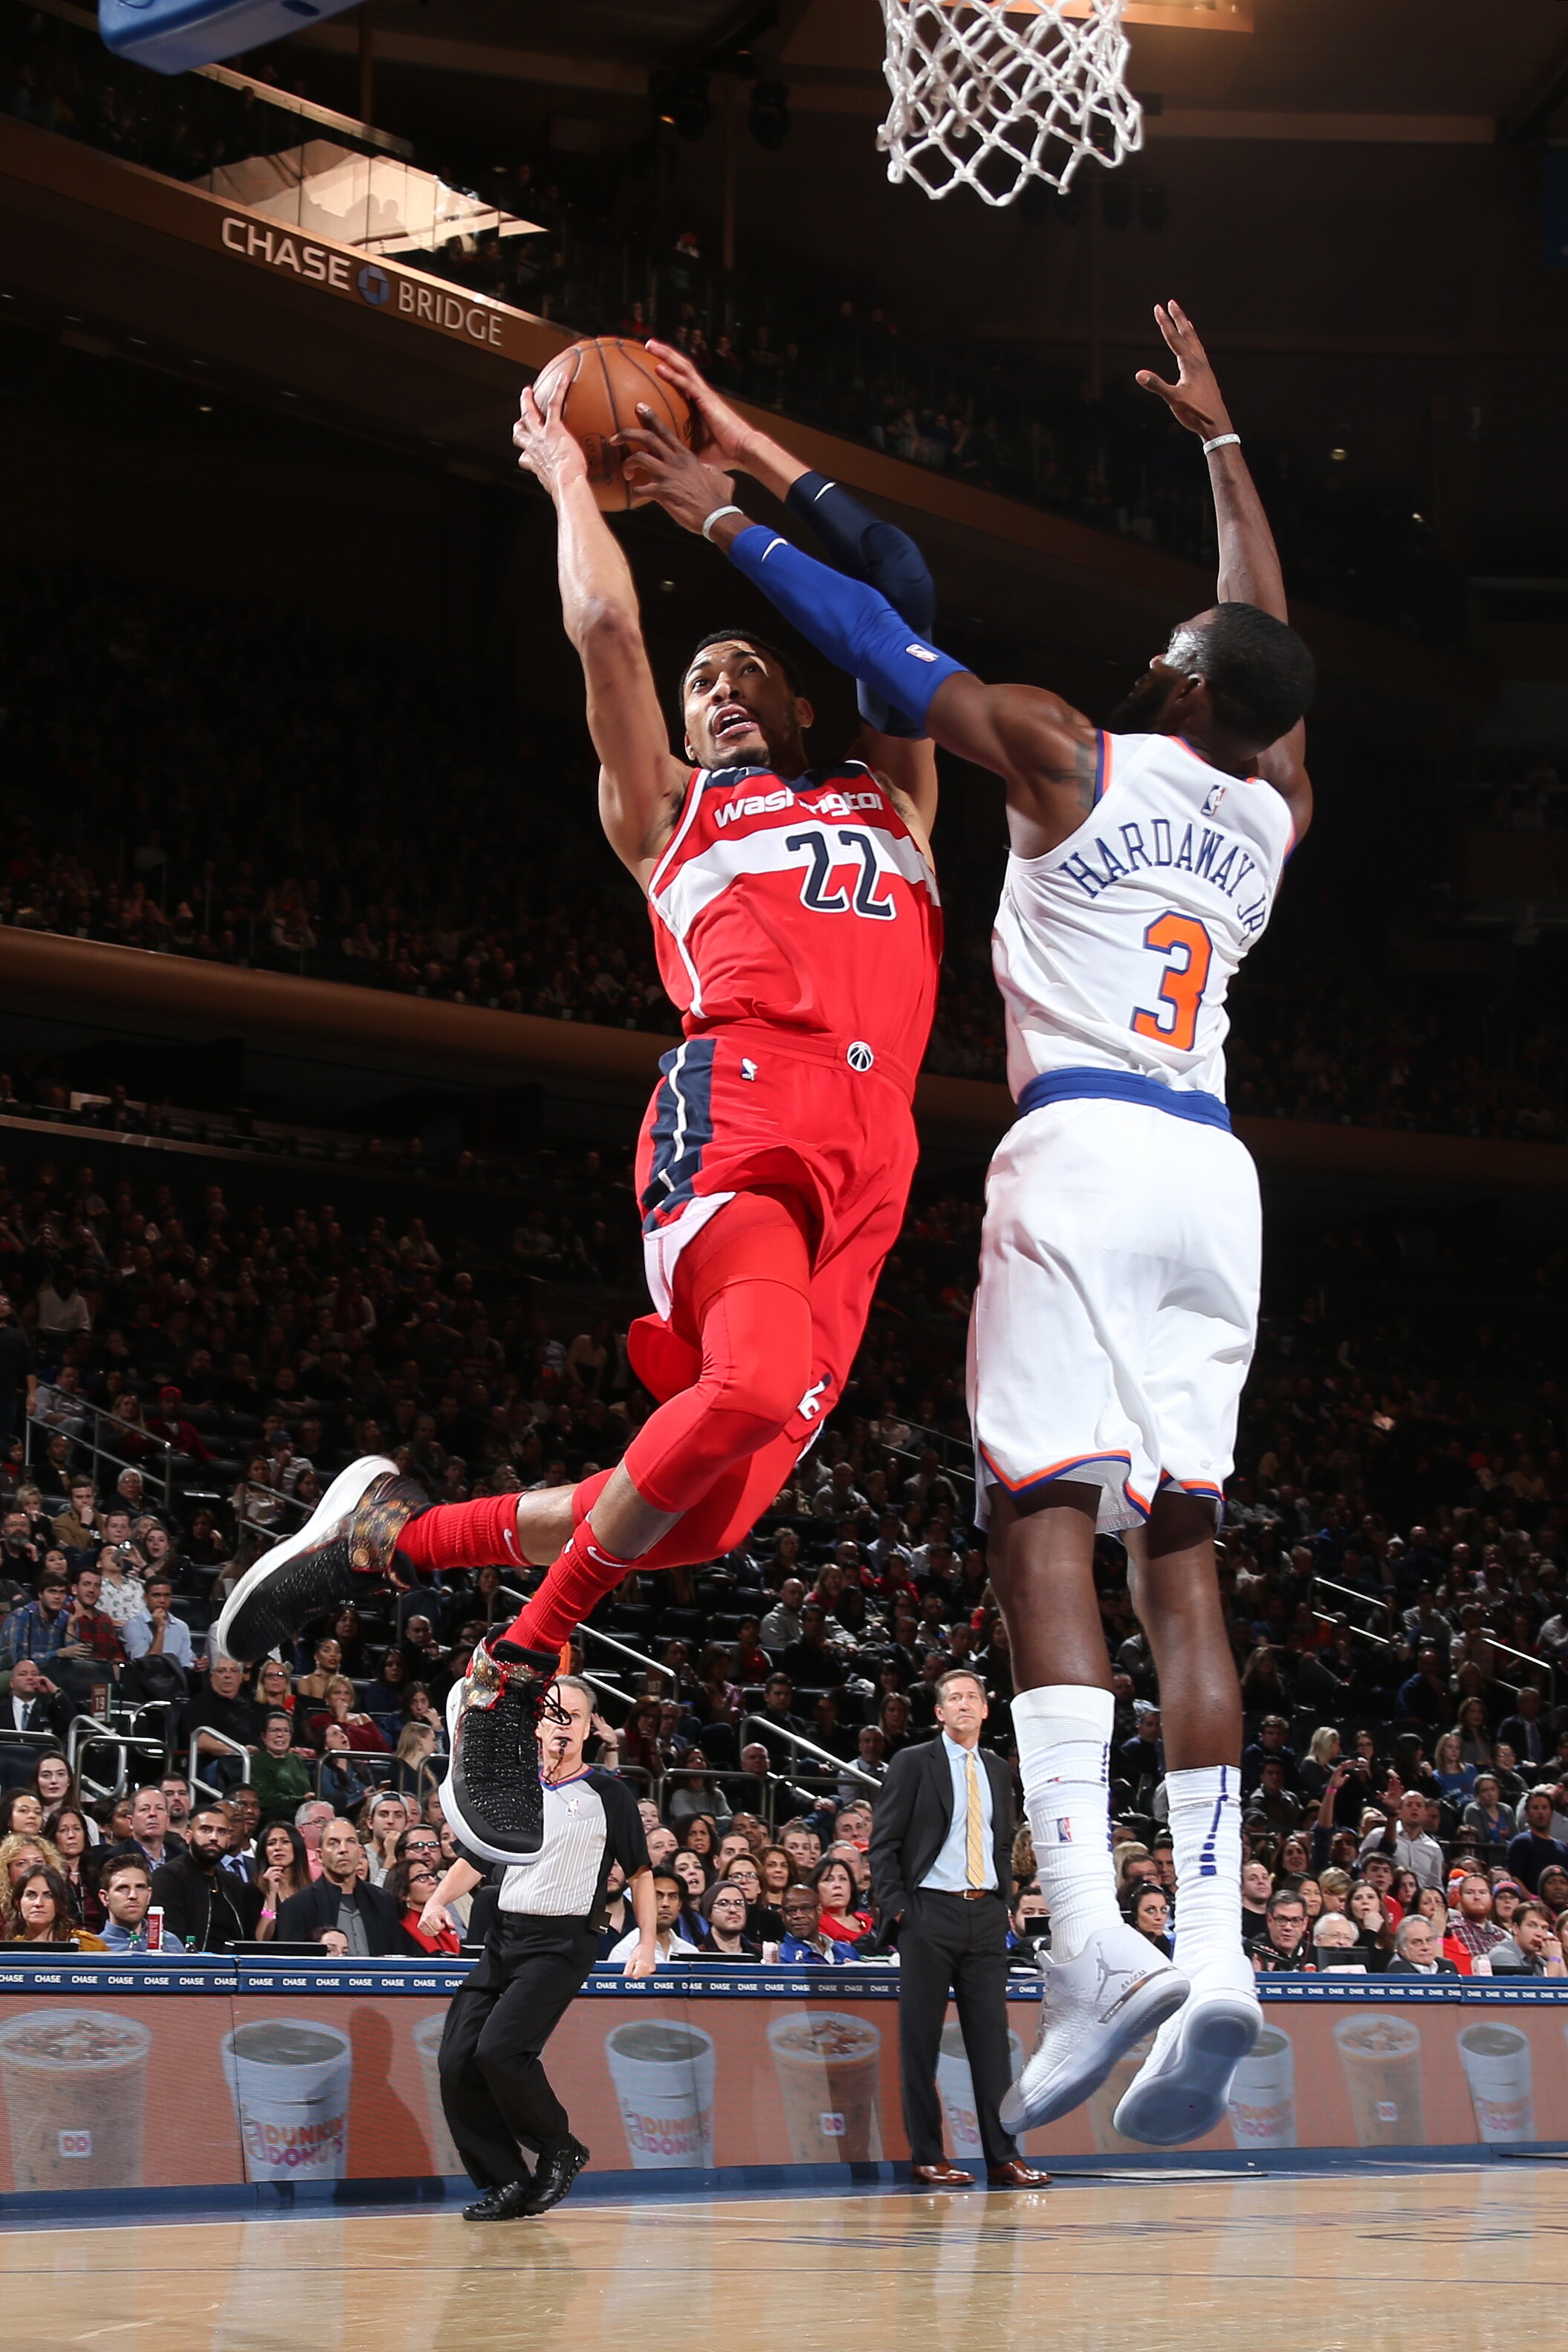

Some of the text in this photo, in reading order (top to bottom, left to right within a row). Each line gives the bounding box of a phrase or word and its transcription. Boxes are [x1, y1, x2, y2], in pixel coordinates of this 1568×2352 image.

[222, 216, 503, 347] CHASE BRIDGE
[713, 785, 883, 829] washngto
[785, 829, 897, 920] 22
[1059, 818, 1254, 898] HARDAWAY
[1129, 910, 1213, 1052] 3
[34, 1974, 62, 1983] CHASE
[71, 1975, 98, 1984] CHASE
[108, 1976, 134, 1985] CHASE
[143, 1977, 169, 1986] CHASE
[178, 1977, 204, 1986] CHASE
[213, 1977, 239, 1986] CHASE
[248, 1977, 273, 1986] CHASE
[282, 1977, 307, 1986] CHASE
[315, 1978, 340, 1986] CHASE
[349, 1978, 373, 1986] CHASE
[380, 1978, 405, 1987] CHASE
[413, 1979, 437, 1987] CHASE
[595, 1981, 618, 1989] CHASE
[624, 1981, 647, 1990] CHASE
[653, 1982, 675, 1990] CHASE
[710, 1982, 730, 1991] CHASE
[737, 1983, 758, 1991] CHASE
[764, 1983, 785, 1992] CHASE
[791, 1983, 811, 1992] CHASE
